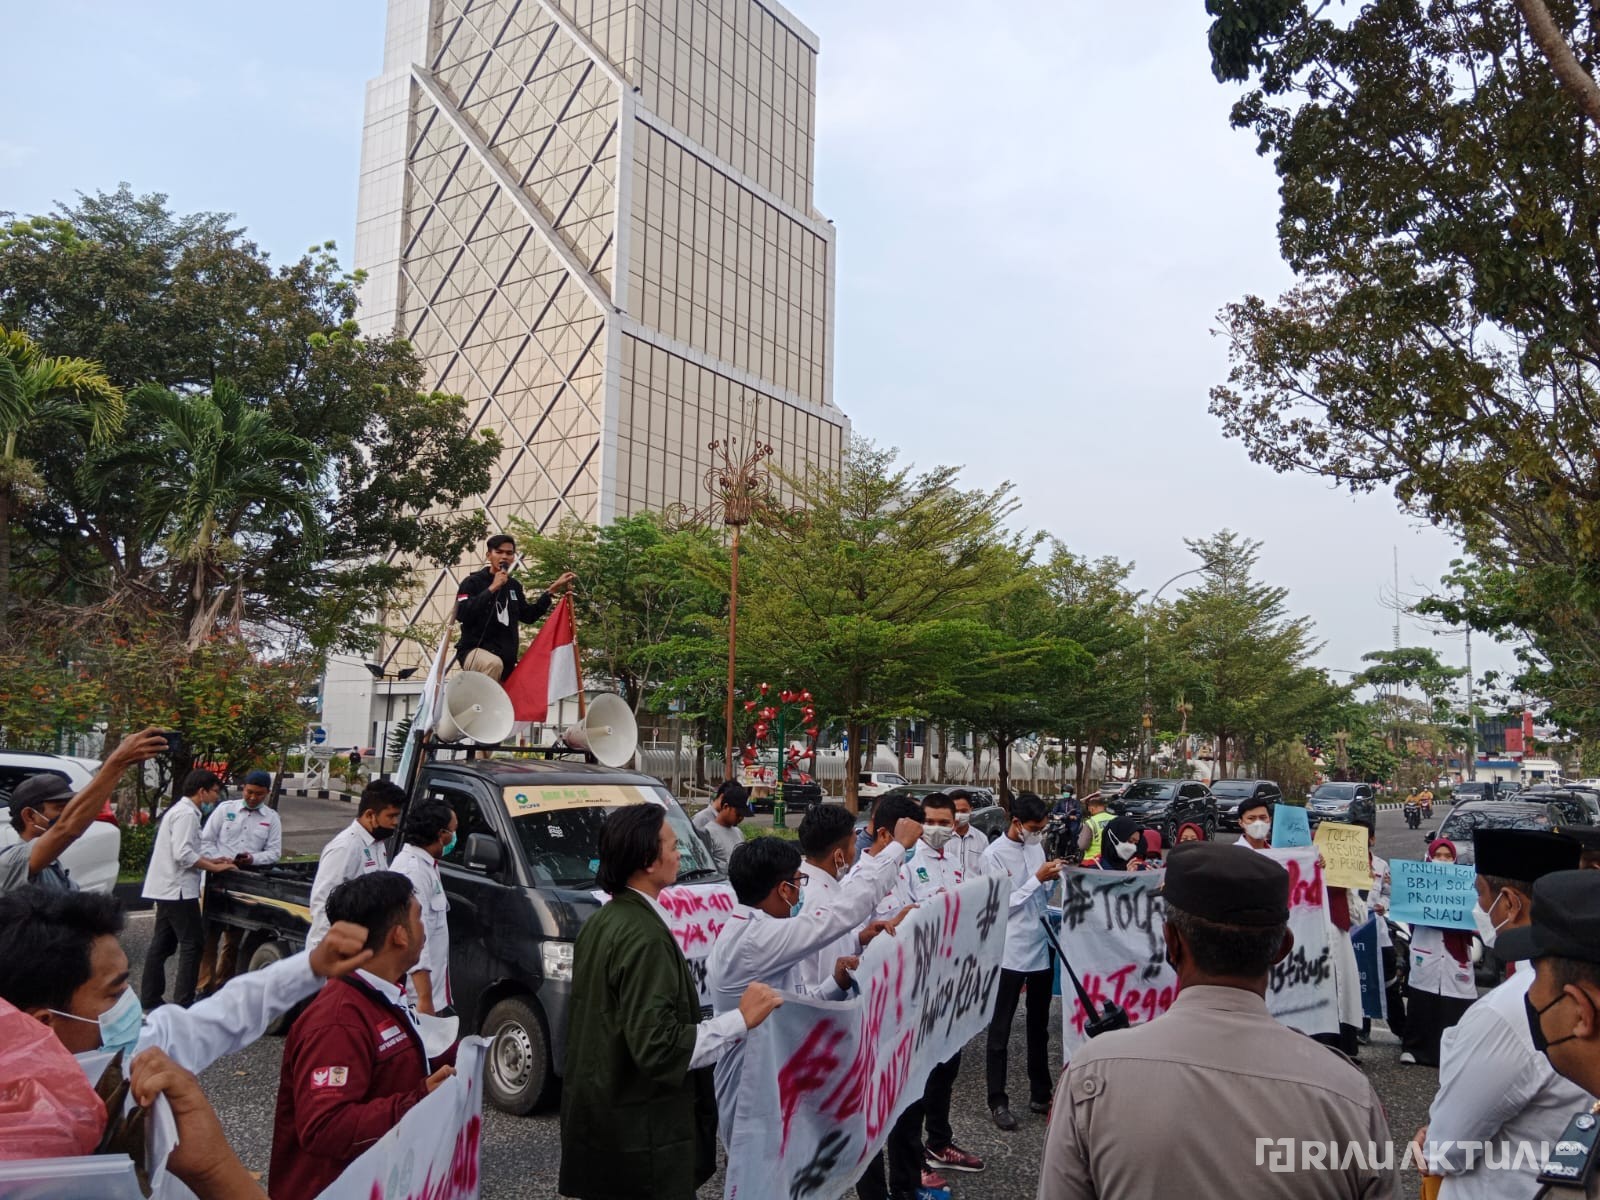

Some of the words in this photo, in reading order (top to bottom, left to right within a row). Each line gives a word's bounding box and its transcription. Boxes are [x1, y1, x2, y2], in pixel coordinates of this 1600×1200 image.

[1327, 828, 1360, 842] TOLAK
[1402, 862, 1447, 876] PENUHI
[1455, 867, 1476, 879] KOU
[1407, 877, 1438, 890] BBM
[1446, 880, 1475, 891] SOLA
[1408, 892, 1466, 906] PROVINSI
[1423, 907, 1463, 921] RIAU
